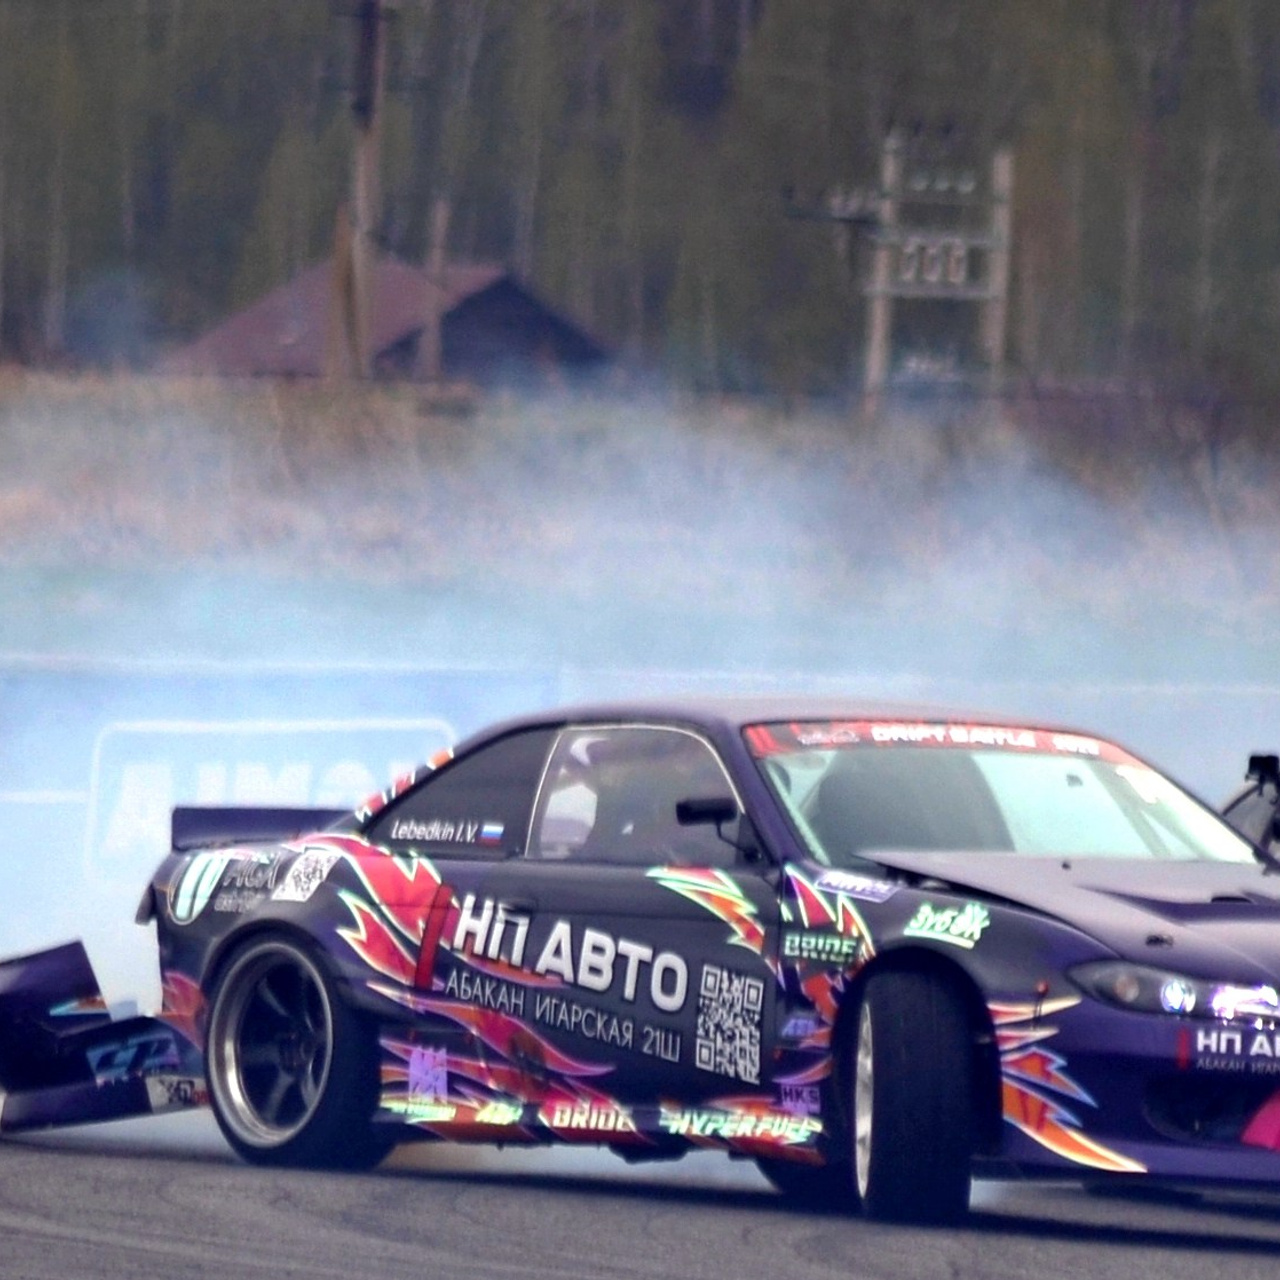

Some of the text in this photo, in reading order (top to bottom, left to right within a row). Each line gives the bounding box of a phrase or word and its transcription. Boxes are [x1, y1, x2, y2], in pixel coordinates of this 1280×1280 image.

[391, 820, 454, 841] Lebedkin
[453, 893, 689, 1013] НП АВТО
[446, 969, 681, 1063] АБАКАН ИГАРСКАЯ 21Ш
[1197, 1029, 1242, 1055] НП
[783, 1086, 818, 1104] HKS
